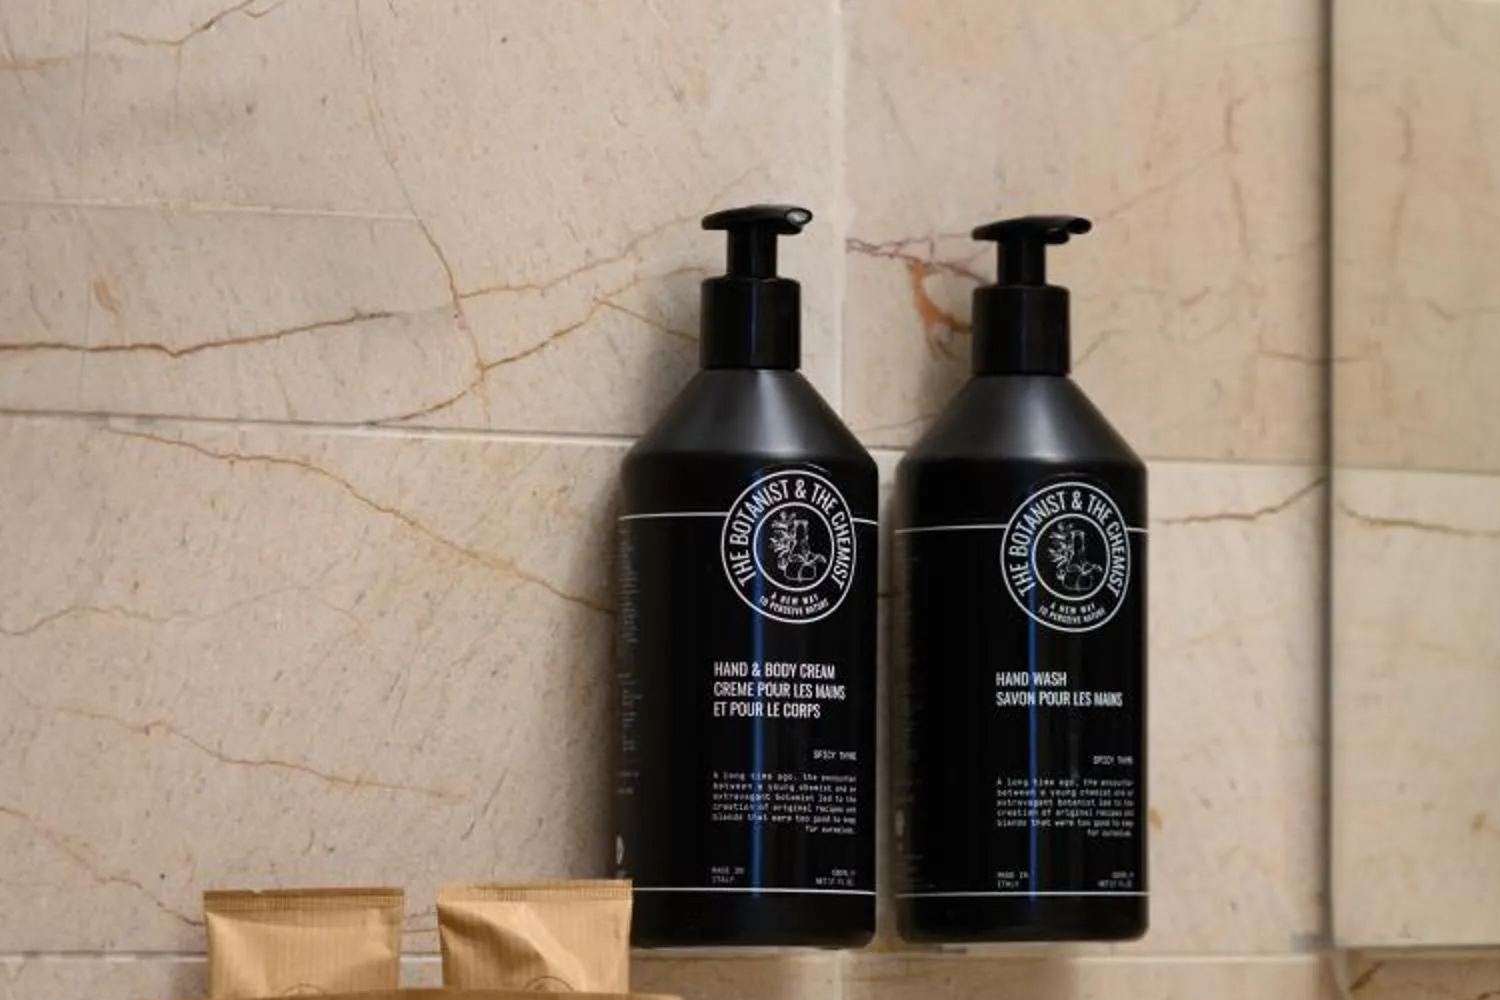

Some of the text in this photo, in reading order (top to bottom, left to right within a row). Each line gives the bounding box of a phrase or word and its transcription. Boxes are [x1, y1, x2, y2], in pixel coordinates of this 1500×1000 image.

[730, 479, 852, 590] THE BOTANIST & THE CHEMIST
[1008, 489, 1126, 599] THE BOTANIST & THE CHEMIST
[713, 661, 836, 680] HAND & BODY CREAM
[995, 671, 1067, 687] HAND WASH
[713, 681, 847, 701] CREME POUR LES MAINS
[995, 691, 1124, 708] SAVON POUR LES MAINS
[713, 701, 821, 719] ET POUR LE CORPS
